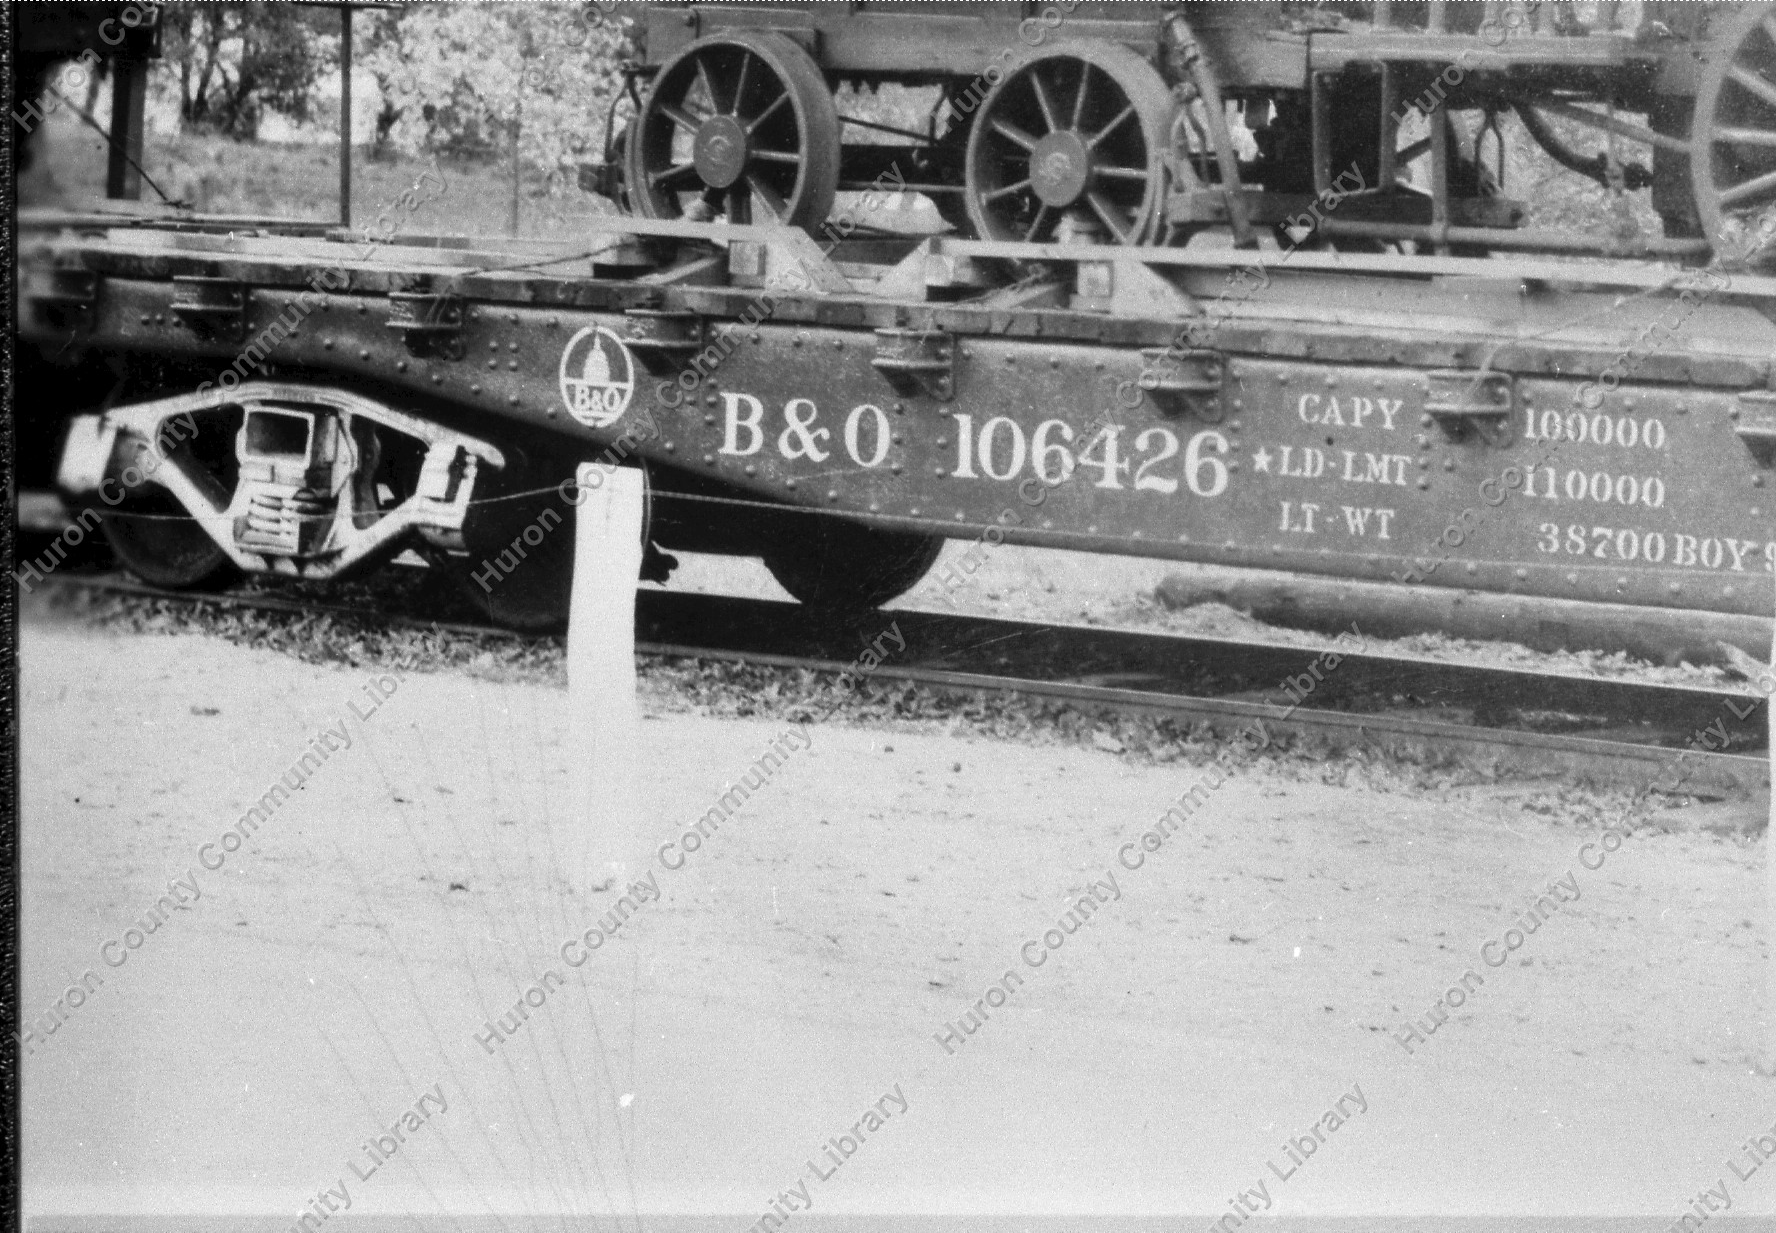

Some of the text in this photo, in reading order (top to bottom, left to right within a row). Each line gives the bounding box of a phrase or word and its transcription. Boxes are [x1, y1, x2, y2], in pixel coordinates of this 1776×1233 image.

[1298, 393, 1666, 450] CAPY 100000
[951, 412, 1231, 498] 106426
[1522, 464, 1666, 509] 110000
[1538, 522, 1666, 564] 38700
